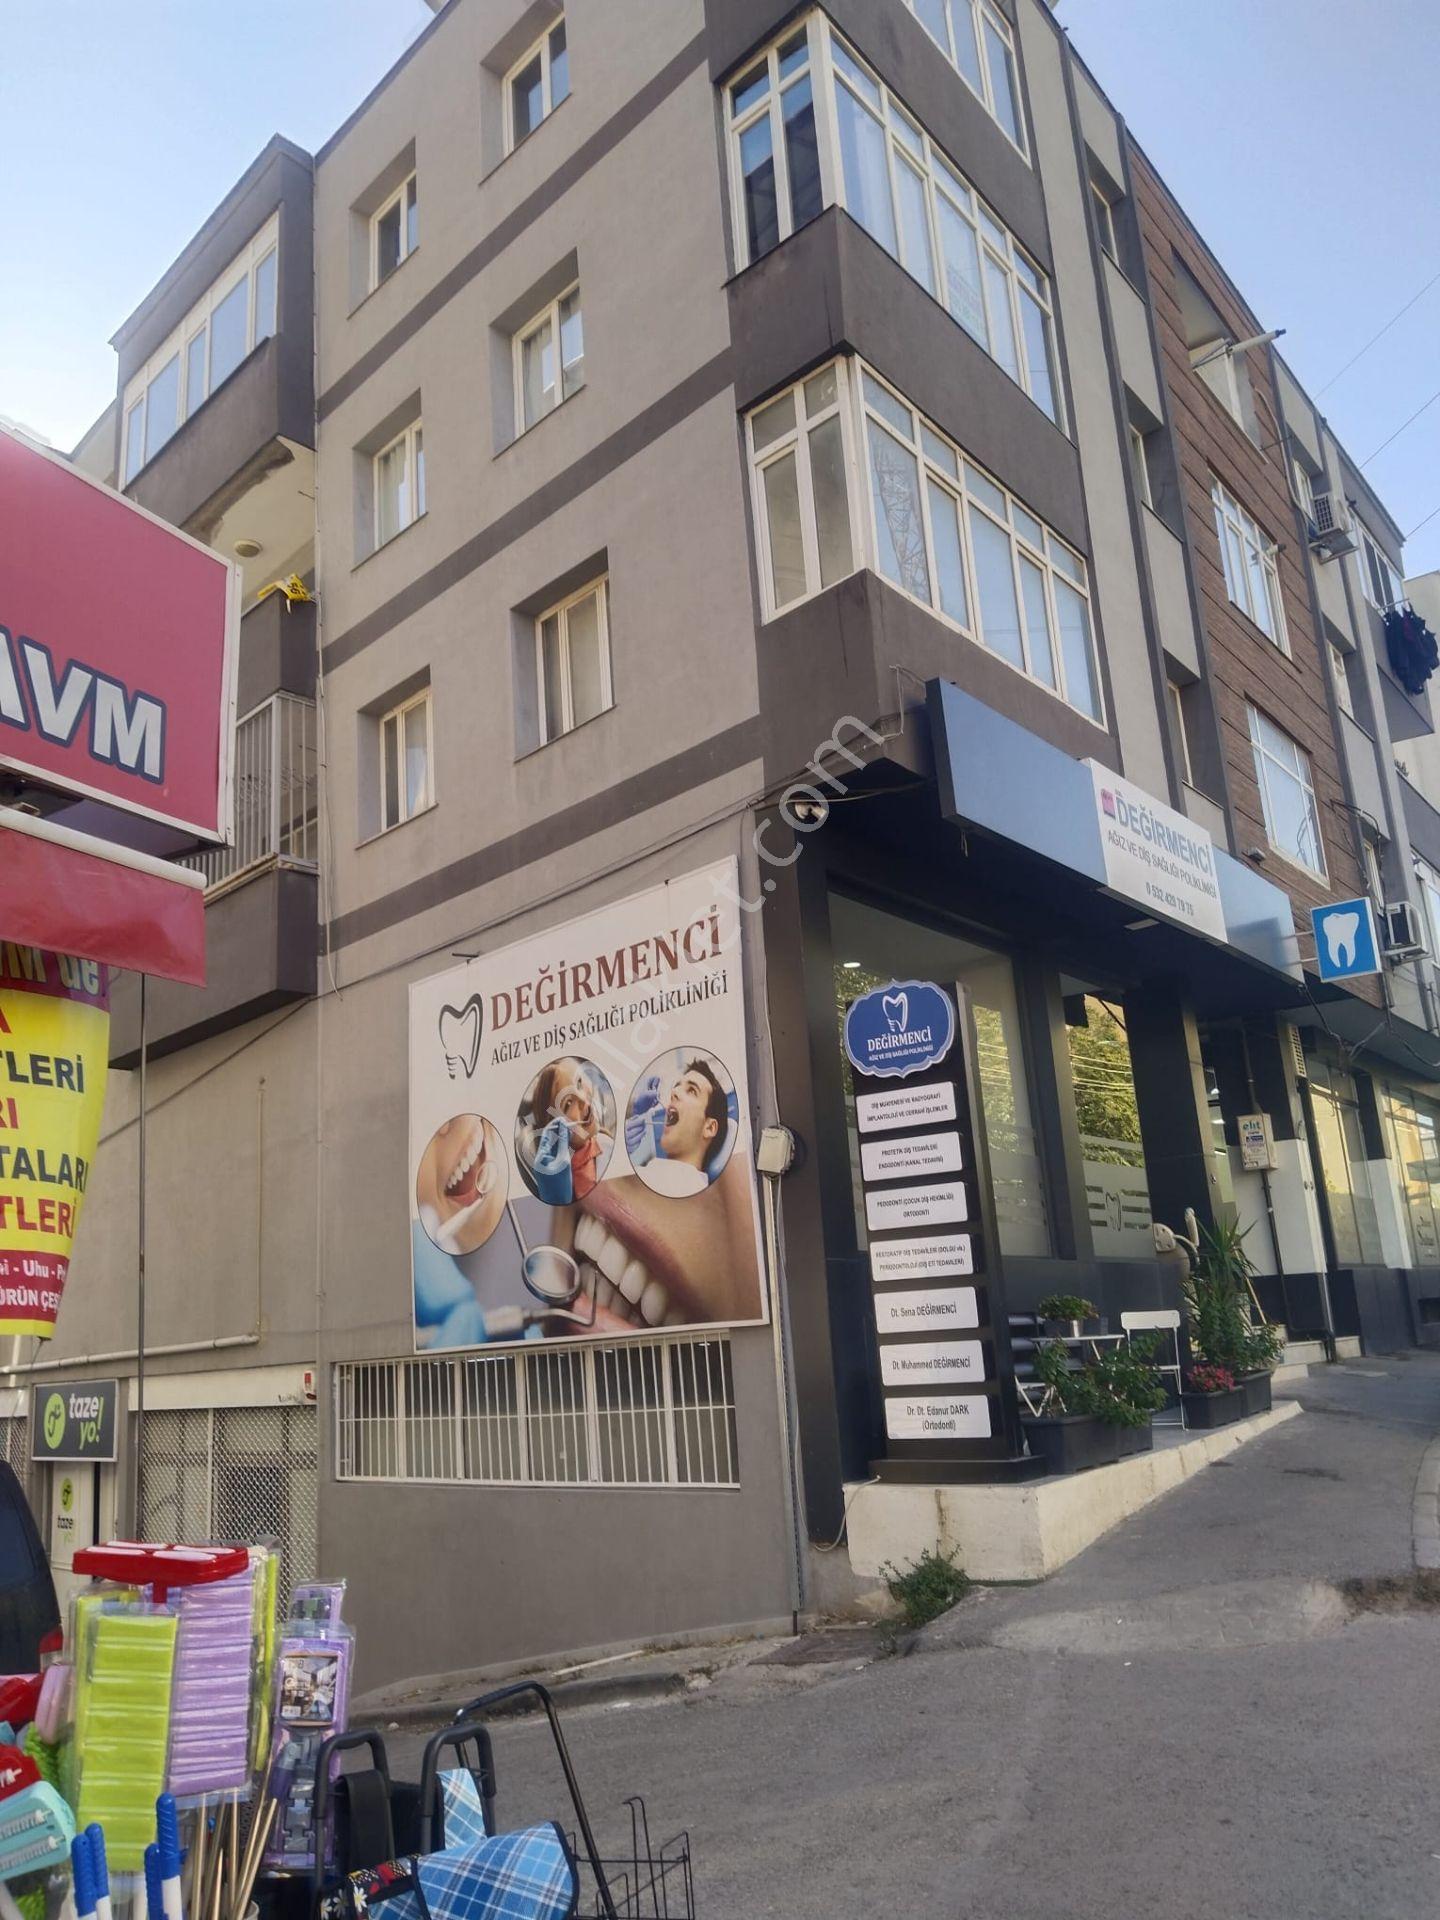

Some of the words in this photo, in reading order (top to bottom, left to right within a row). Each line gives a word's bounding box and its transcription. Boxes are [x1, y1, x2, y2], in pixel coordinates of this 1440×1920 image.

[490, 903, 723, 1031] DEĞİRMENCİ
[491, 1038, 521, 1066] AĞIZ
[523, 1033, 541, 1055] VE
[543, 1024, 566, 1048] DİŞ
[569, 1004, 626, 1041] SAĞLIĞI
[628, 969, 729, 1022] POLİKLİNİĞİ
[867, 1025, 932, 1052] DEĞİRMENCİ
[0, 1050, 84, 1093] LERİ
[69, 1392, 99, 1419] taze
